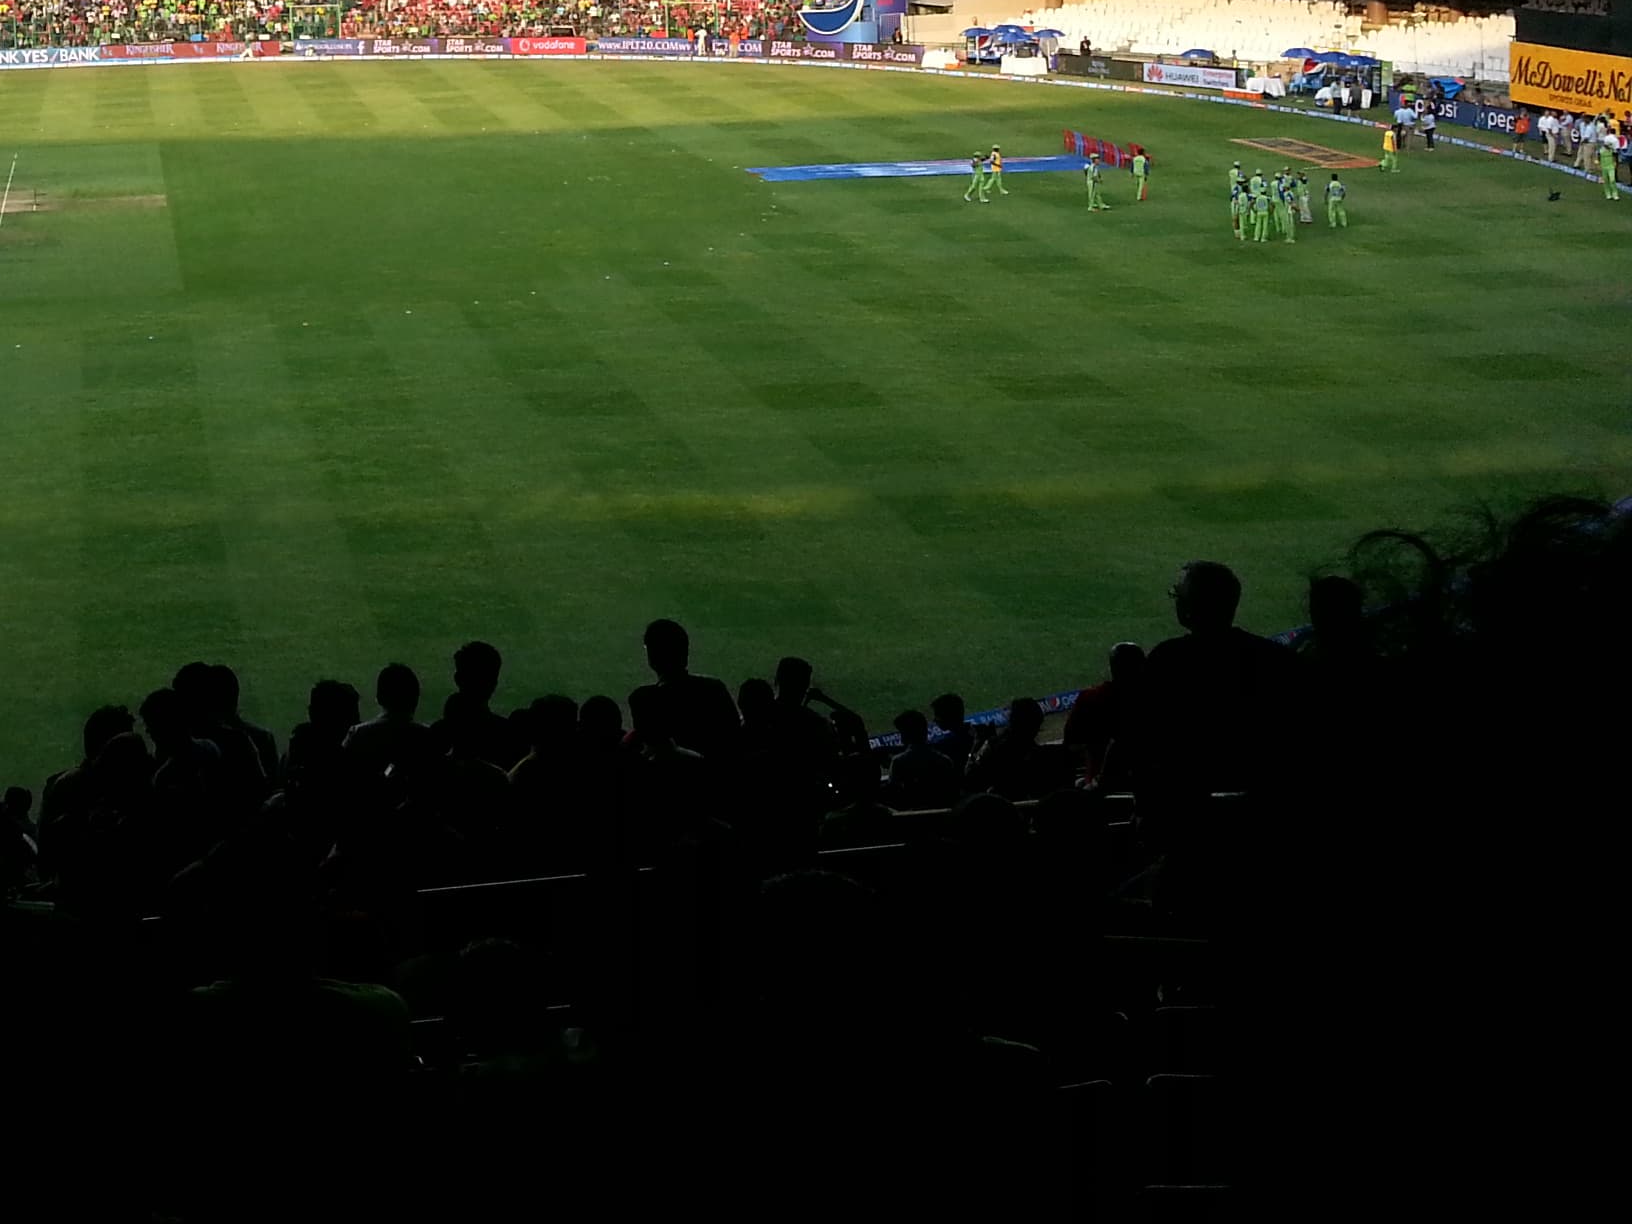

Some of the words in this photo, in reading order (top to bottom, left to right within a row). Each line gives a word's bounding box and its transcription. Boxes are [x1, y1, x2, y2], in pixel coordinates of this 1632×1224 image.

[216, 41, 264, 53] KINGFIER
[373, 45, 400, 53] SPORTS
[411, 45, 431, 53] .COM
[446, 44, 472, 53] SPORTS
[533, 39, 576, 50] vodafone
[771, 41, 792, 49] STAR
[853, 44, 873, 52] STAR
[125, 44, 174, 56] KINGFISHER
[770, 48, 801, 57] SPORTS
[813, 50, 836, 58] .COM
[21, 50, 49, 63] YES
[61, 47, 100, 62] BANK
[852, 51, 882, 60] SPORTS
[894, 53, 916, 62] .COM
[1165, 71, 1199, 83] HUAWEI
[1511, 55, 1605, 98] McDowell's
[1414, 98, 1457, 119] psi
[1487, 112, 1516, 134] pep
